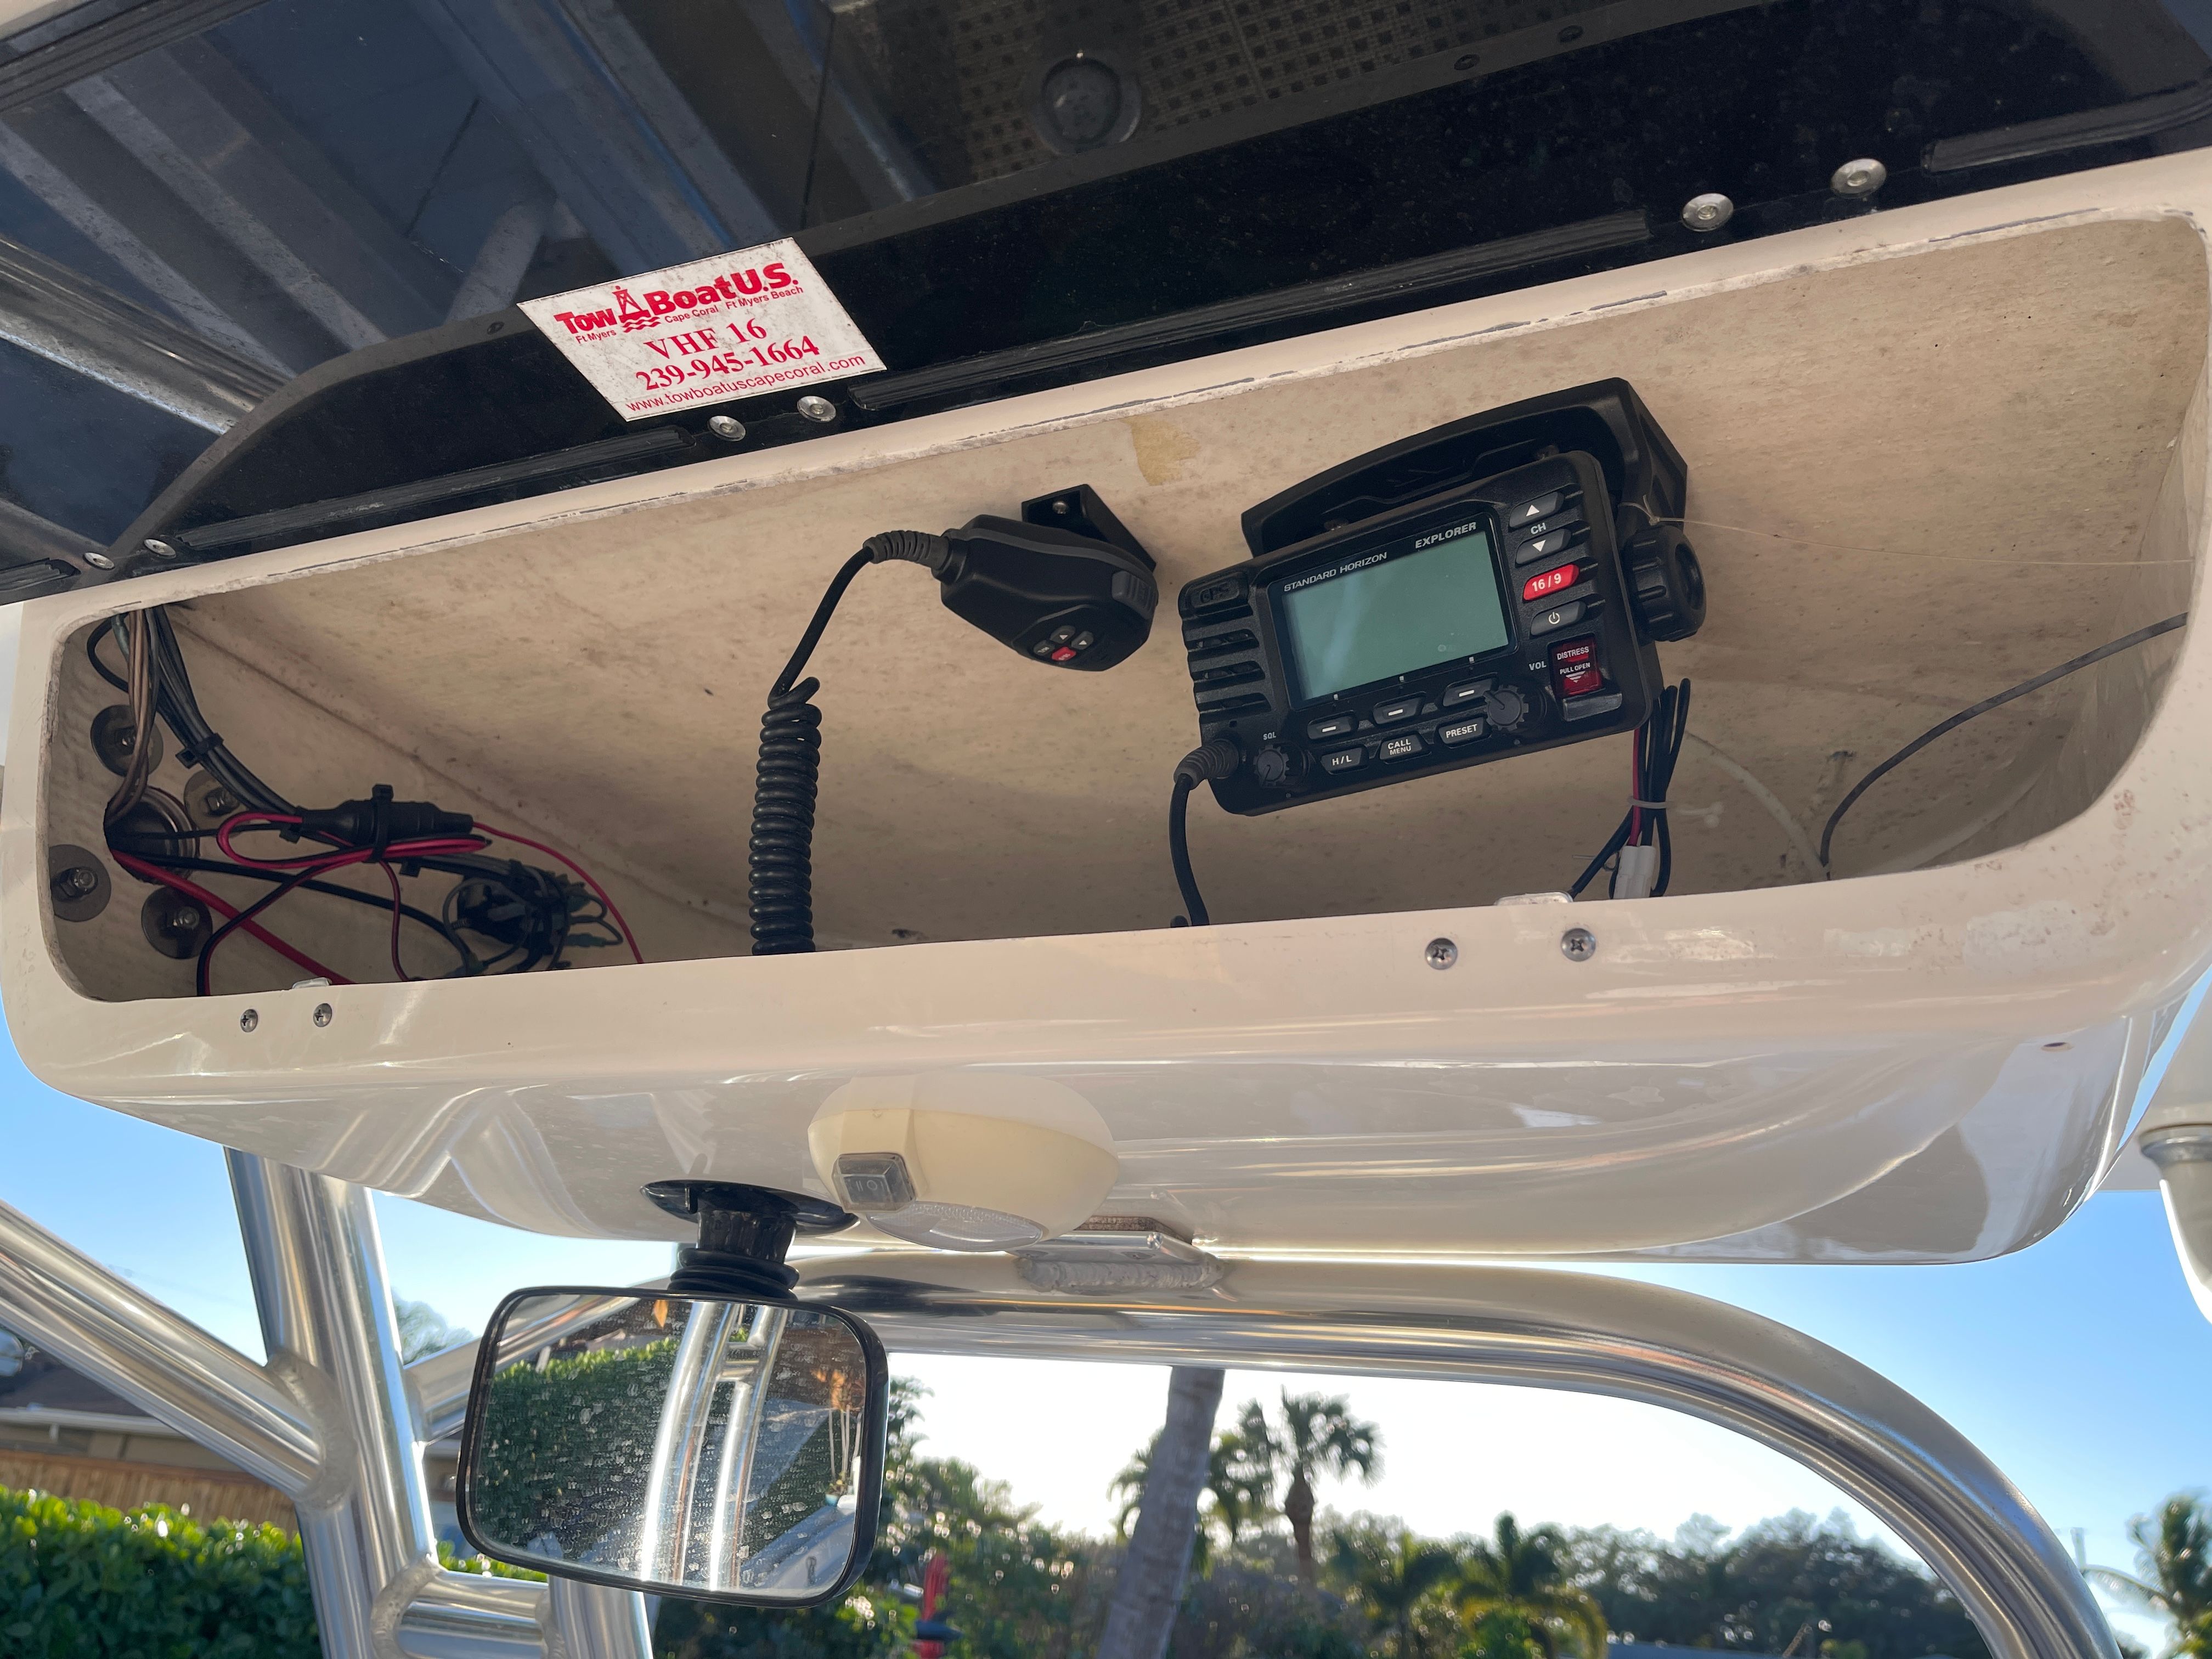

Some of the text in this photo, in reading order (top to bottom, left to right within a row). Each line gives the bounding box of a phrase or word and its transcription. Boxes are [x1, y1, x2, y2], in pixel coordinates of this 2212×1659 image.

[664, 285, 804, 323] Cape Coral Ft Myers Beach
[575, 329, 617, 345] Ft Myers
[644, 318, 767, 360] VHF 16
[636, 335, 820, 391] 239-945-1664
[626, 354, 866, 411] www.towboatuscapecoral.com
[1415, 522, 1477, 549] EXPLORER
[1530, 522, 1547, 535] CH
[1284, 552, 1387, 592] STANDARD HORIZON
[1556, 646, 1589, 661] DISTRESS
[1528, 661, 1547, 671] VOL
[1559, 662, 1590, 675] PULL OPEN
[1445, 724, 1477, 739] PRESET
[1387, 738, 1411, 751] CALL
[1389, 745, 1412, 756] MENU
